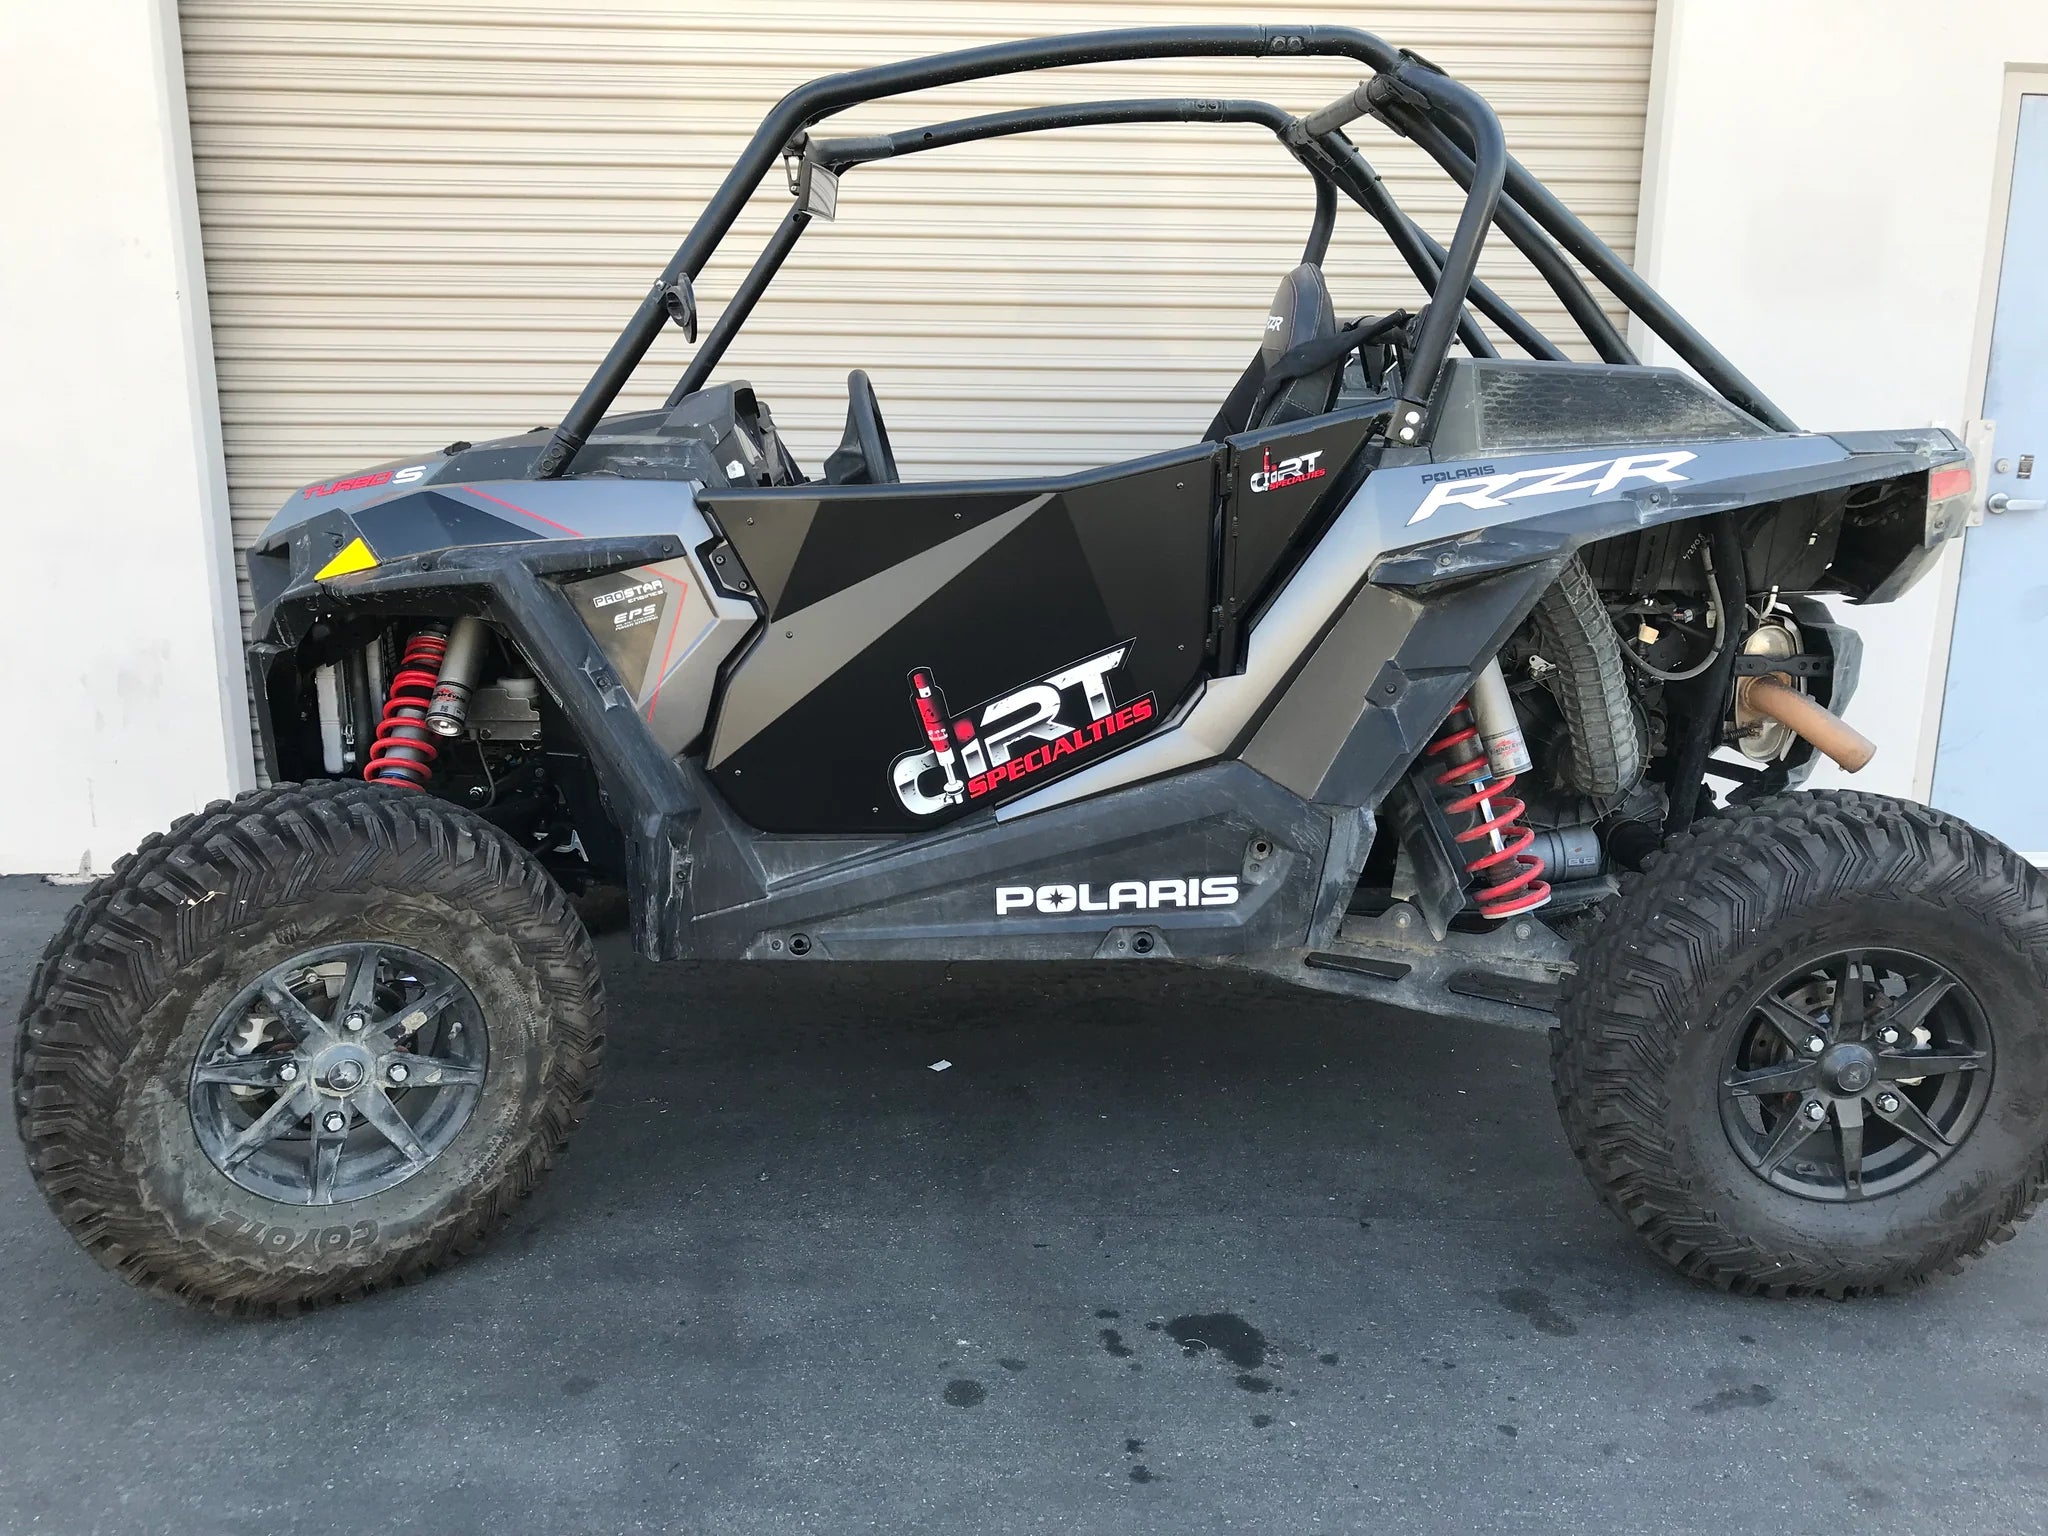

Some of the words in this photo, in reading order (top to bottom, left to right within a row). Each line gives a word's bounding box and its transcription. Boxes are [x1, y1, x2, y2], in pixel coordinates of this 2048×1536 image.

[303, 470, 395, 500] TURBO
[391, 465, 428, 484] S
[1269, 468, 1327, 491] SPECIALTIES
[1404, 450, 1699, 527] RZR
[1421, 465, 1496, 484] POLARIS
[593, 579, 663, 608] PROSTAR
[613, 603, 657, 624] EPS
[966, 698, 1154, 799] SPECIALTIES
[995, 876, 1240, 916] POLARIS
